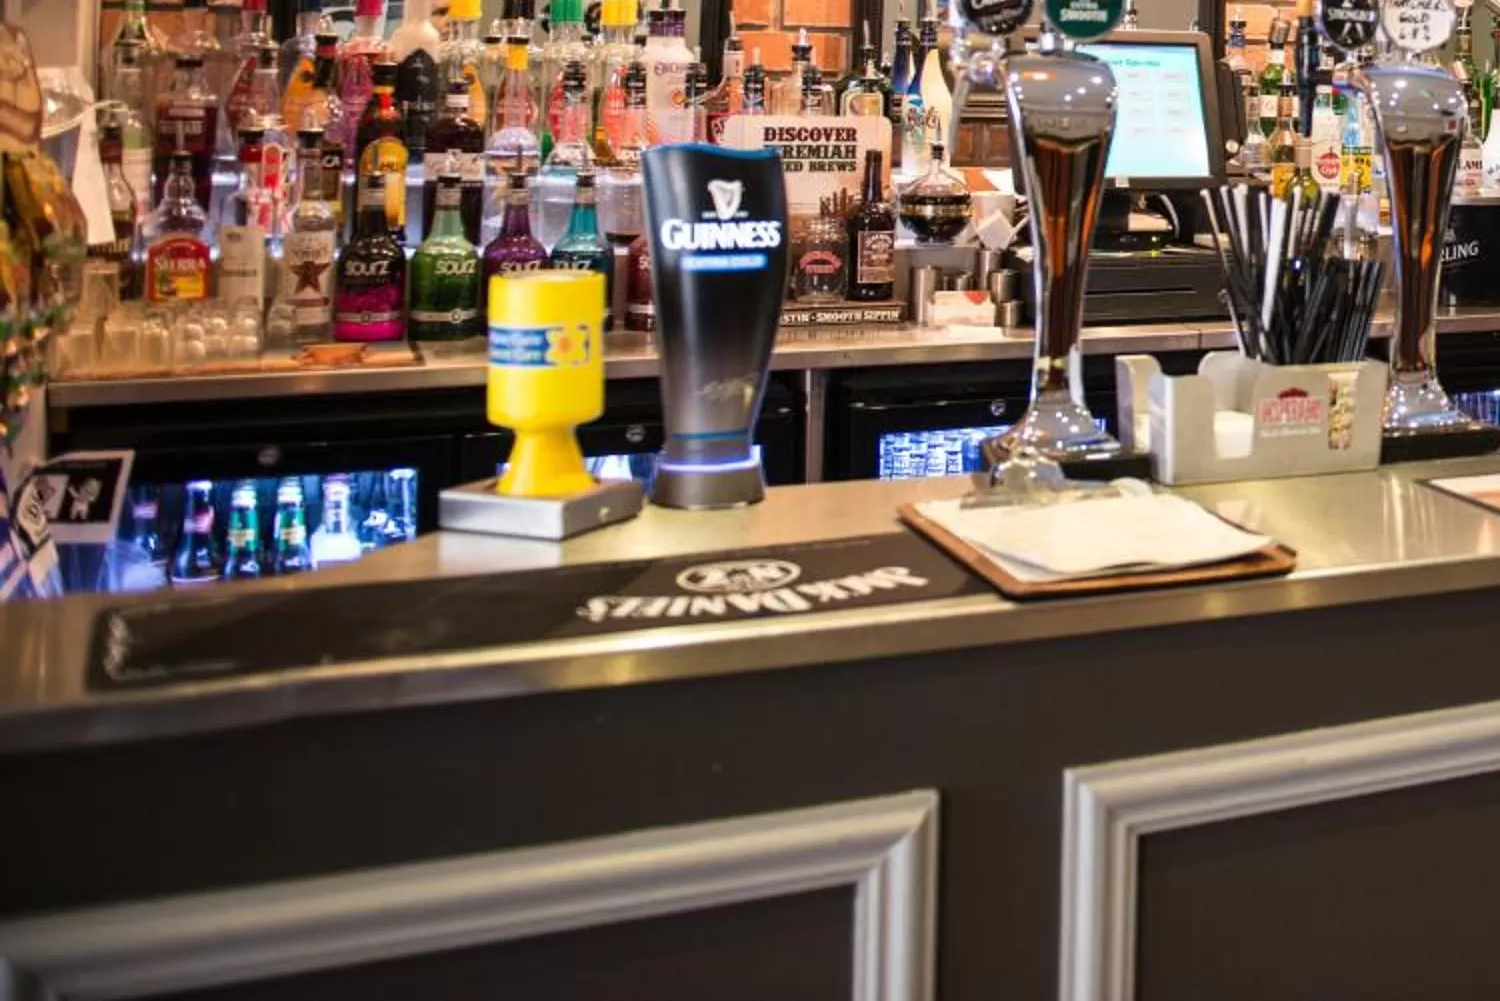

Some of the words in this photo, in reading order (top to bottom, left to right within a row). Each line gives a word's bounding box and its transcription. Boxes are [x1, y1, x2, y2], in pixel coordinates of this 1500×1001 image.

[763, 126, 857, 142] DISCOVER
[775, 144, 857, 160] REMIAH
[808, 161, 857, 172] BREWS
[661, 218, 781, 251] GUINNESS
